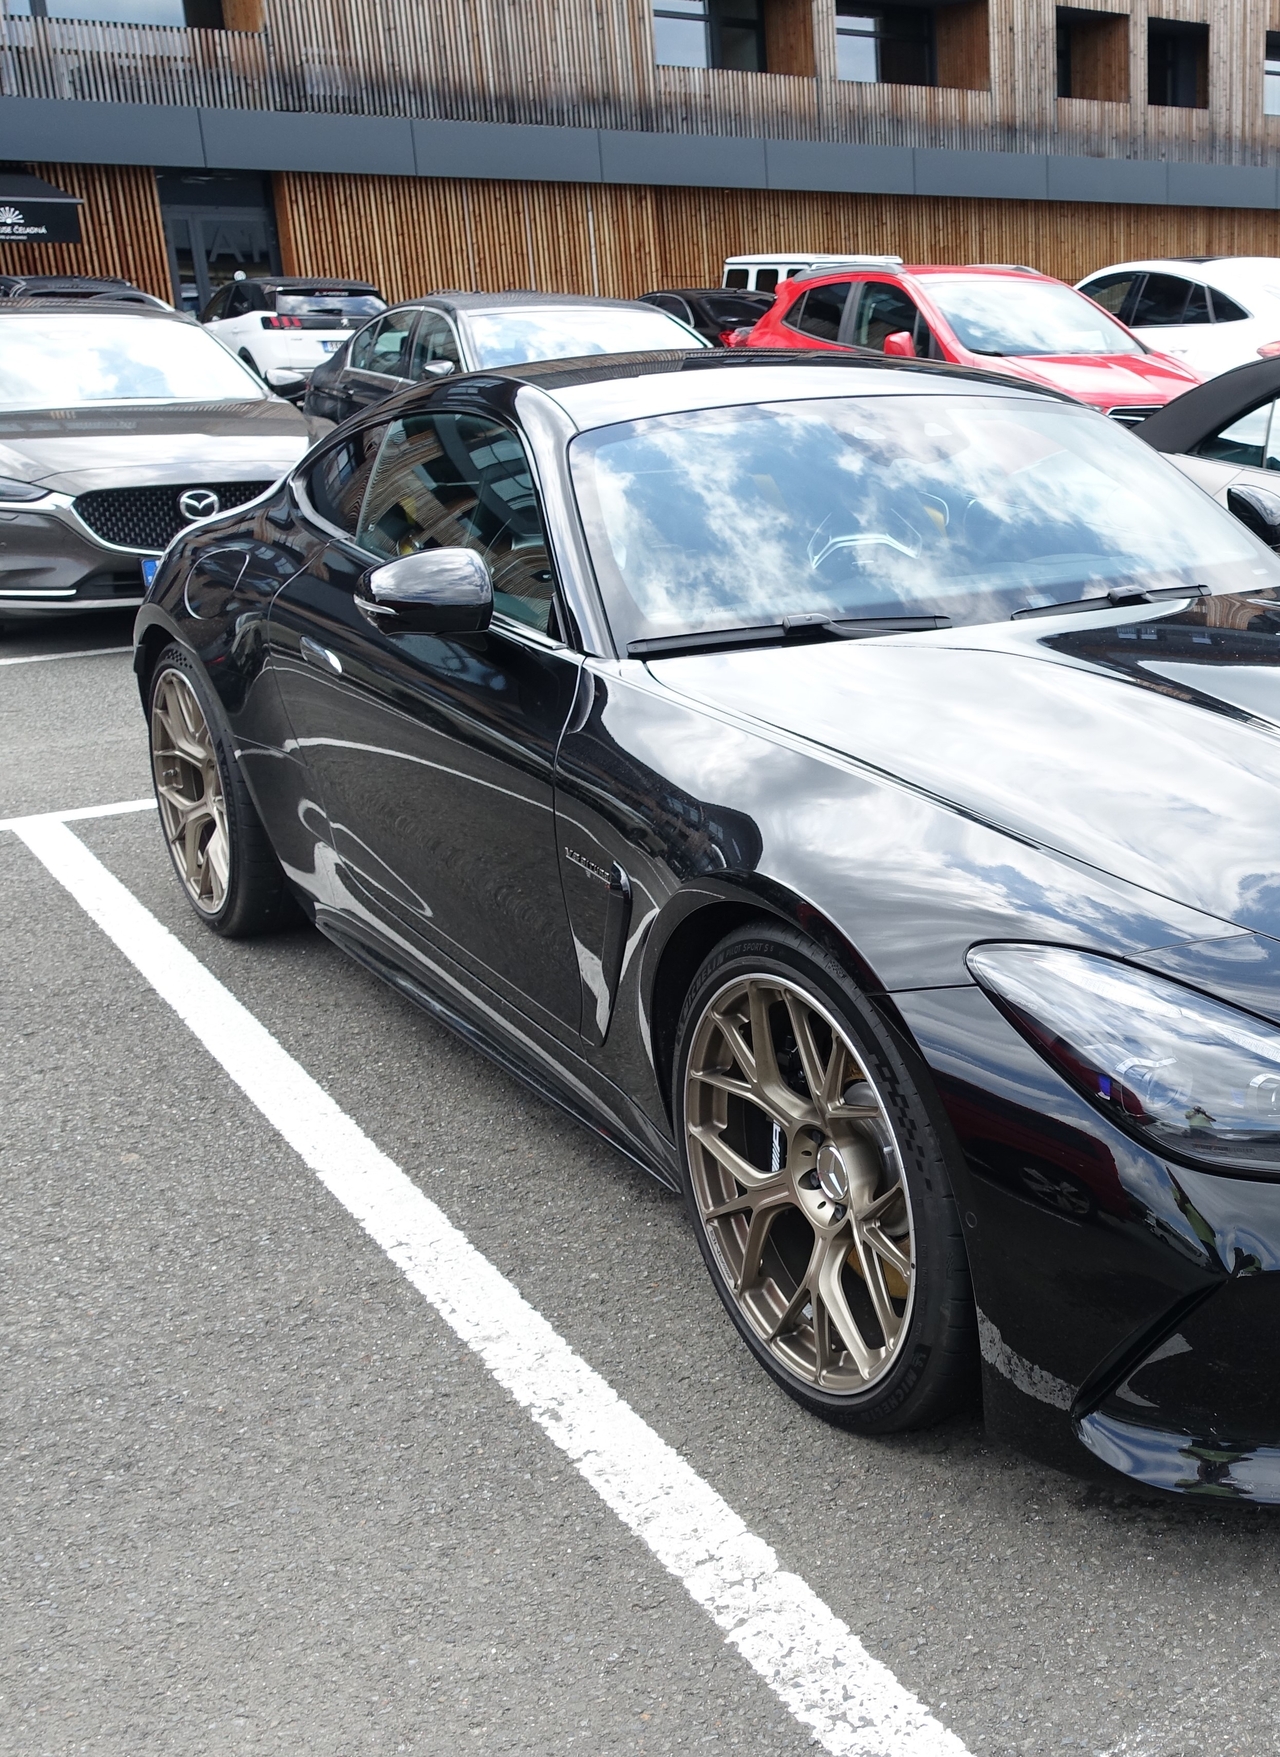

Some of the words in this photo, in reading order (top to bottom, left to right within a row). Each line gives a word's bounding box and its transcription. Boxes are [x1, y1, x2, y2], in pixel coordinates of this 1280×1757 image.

[683, 950, 725, 1020] MICHELIN
[725, 944, 742, 958] PILOT
[742, 943, 764, 952] SPORT
[764, 944, 769, 952] S
